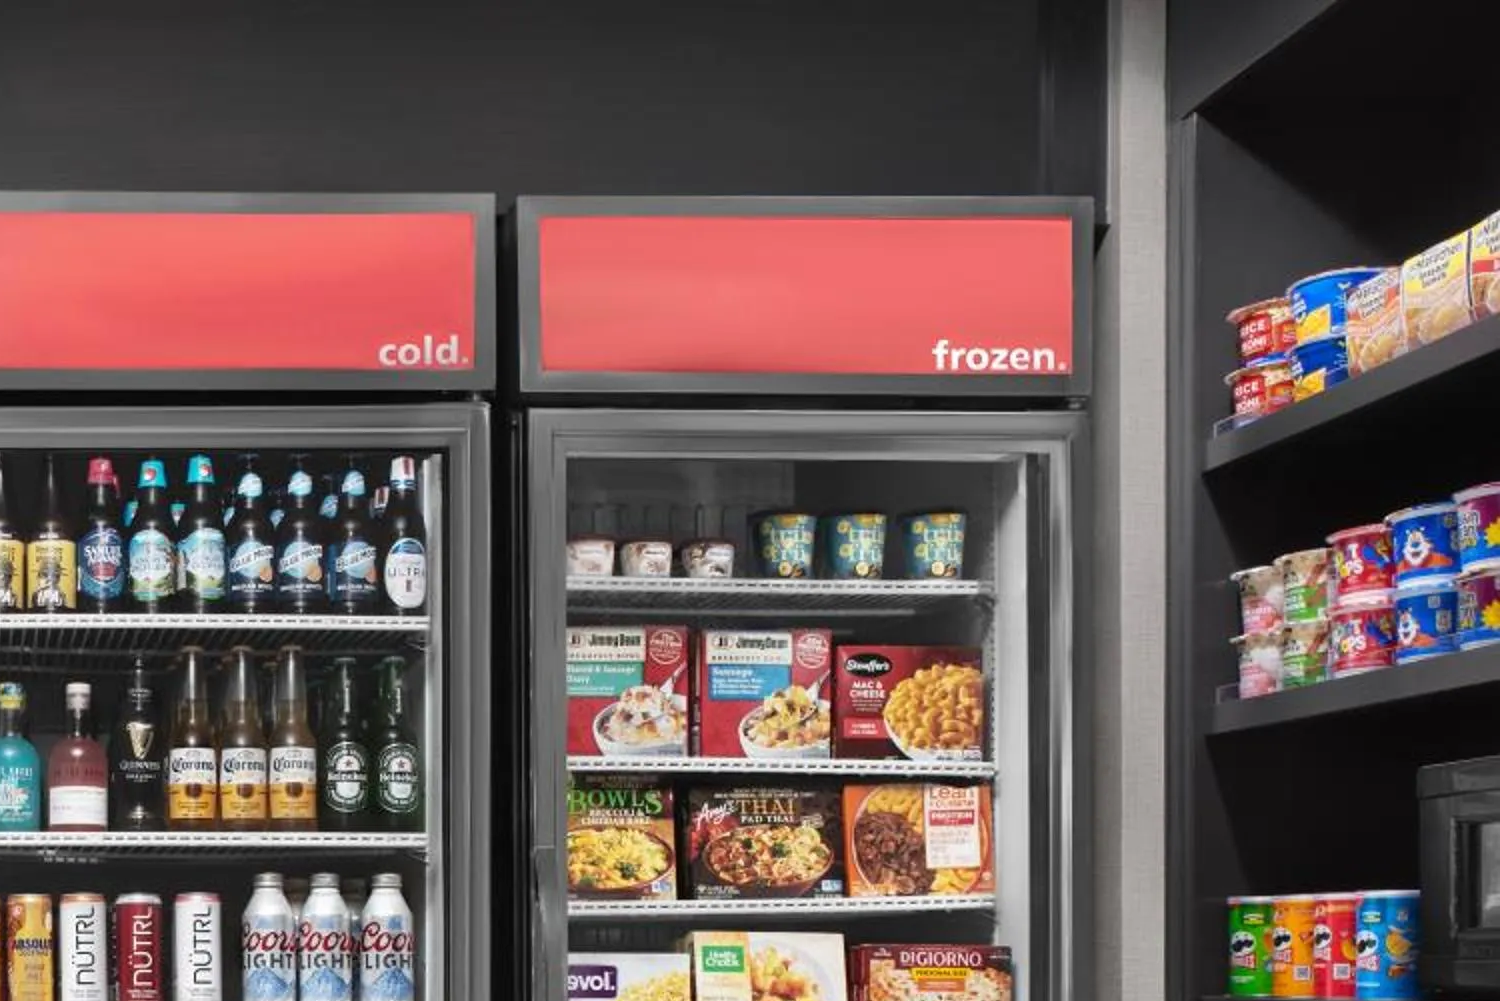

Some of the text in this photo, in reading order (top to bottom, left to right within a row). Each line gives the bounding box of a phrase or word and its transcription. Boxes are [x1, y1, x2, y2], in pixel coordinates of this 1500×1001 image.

[378, 335, 468, 365] cold.
[932, 339, 1068, 371] frozen.
[712, 667, 754, 678] Sausage
[845, 658, 891, 676] Stouffer's
[849, 689, 886, 699] CHEESE
[852, 681, 875, 690] MAC
[171, 756, 215, 773] Corona
[223, 756, 265, 773] Corona
[273, 756, 315, 773] Corona
[692, 799, 796, 825] Amy's THAI
[740, 814, 795, 824] PAD THAI
[900, 951, 983, 967] DIGIORNO
